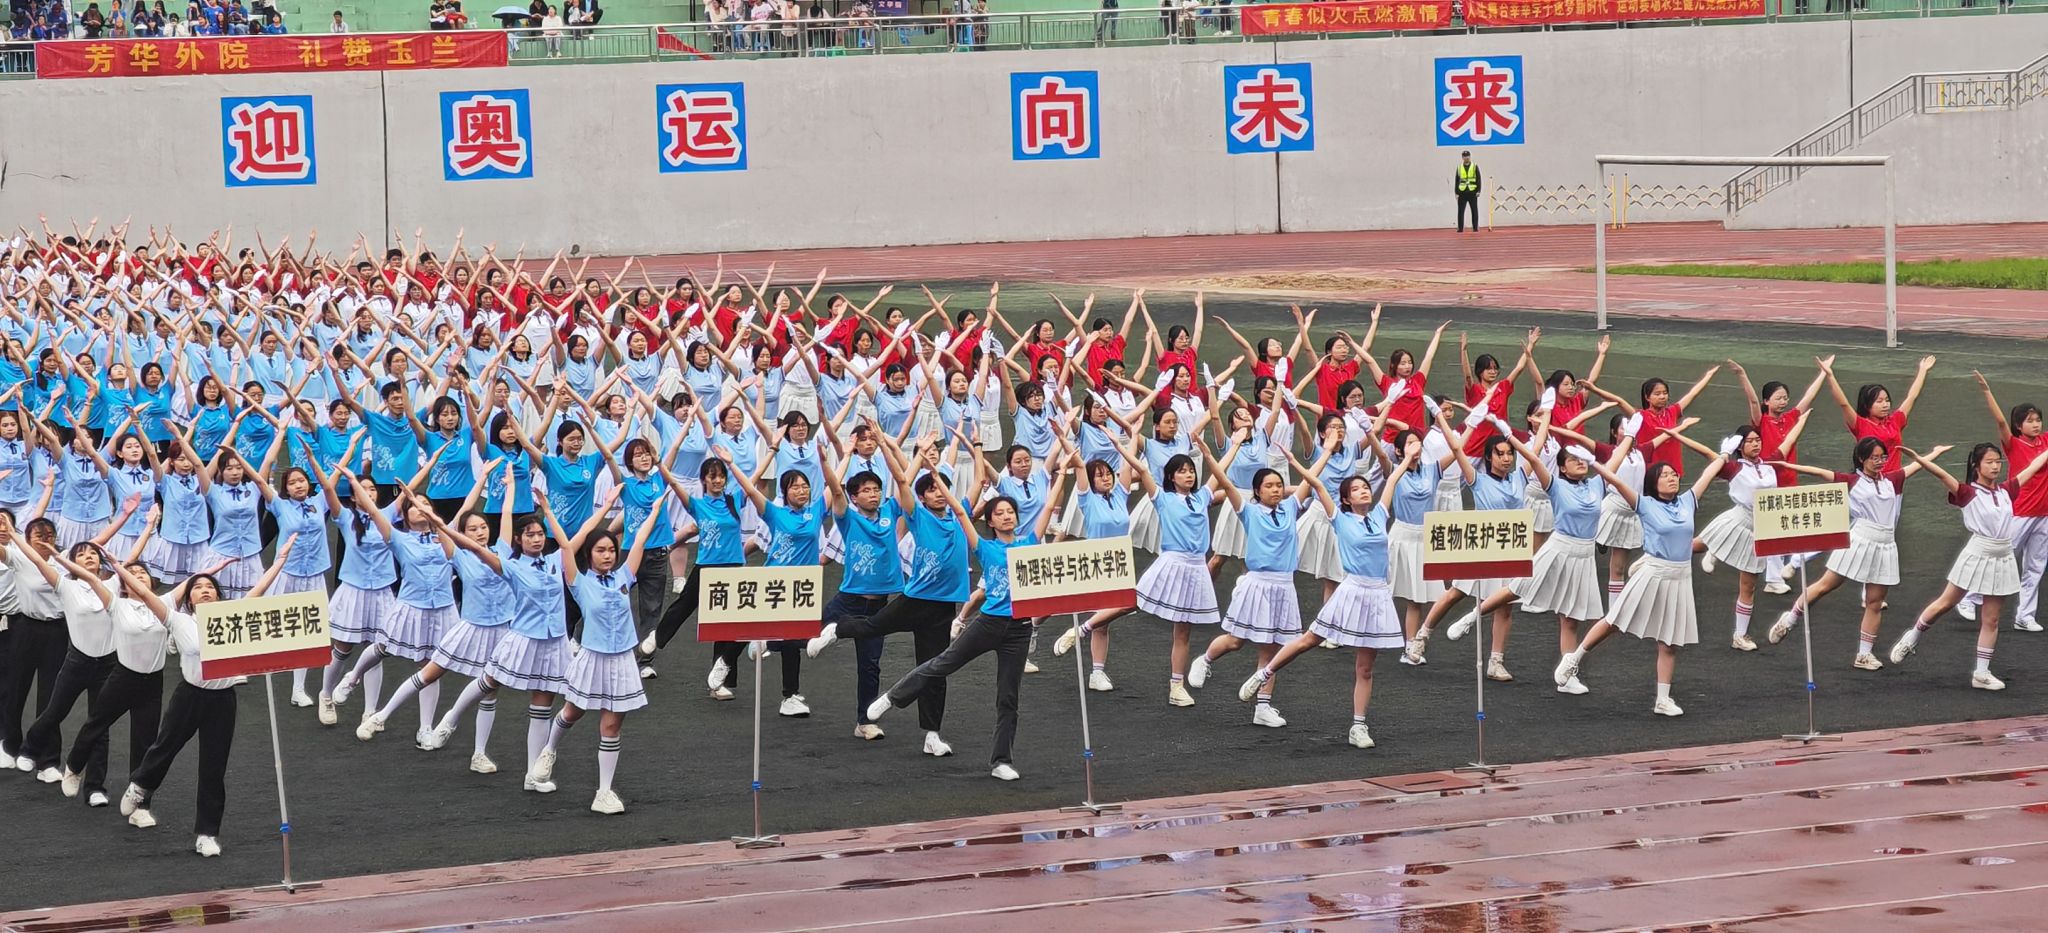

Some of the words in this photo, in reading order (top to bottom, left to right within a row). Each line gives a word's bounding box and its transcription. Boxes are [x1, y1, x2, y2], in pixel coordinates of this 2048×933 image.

[1263, 5, 1439, 27] 青春似火点燃激情
[84, 40, 250, 73] 芳华外院
[298, 35, 461, 68] 礼赞玉兰
[234, 107, 304, 173] 迎
[453, 101, 521, 168] 奥
[668, 95, 736, 159] 运
[1026, 83, 1085, 149] 向
[1237, 74, 1303, 142] 未
[1448, 66, 1514, 136] 来
[1758, 489, 1844, 512] 计算机与信息科学学院
[1430, 521, 1528, 551] 植物保护学院
[1781, 512, 1822, 530] 软件学院
[1015, 548, 1129, 588] 物理科学与技术学院
[708, 579, 815, 611] 商贸学院
[206, 604, 322, 646] 经济管理学院
